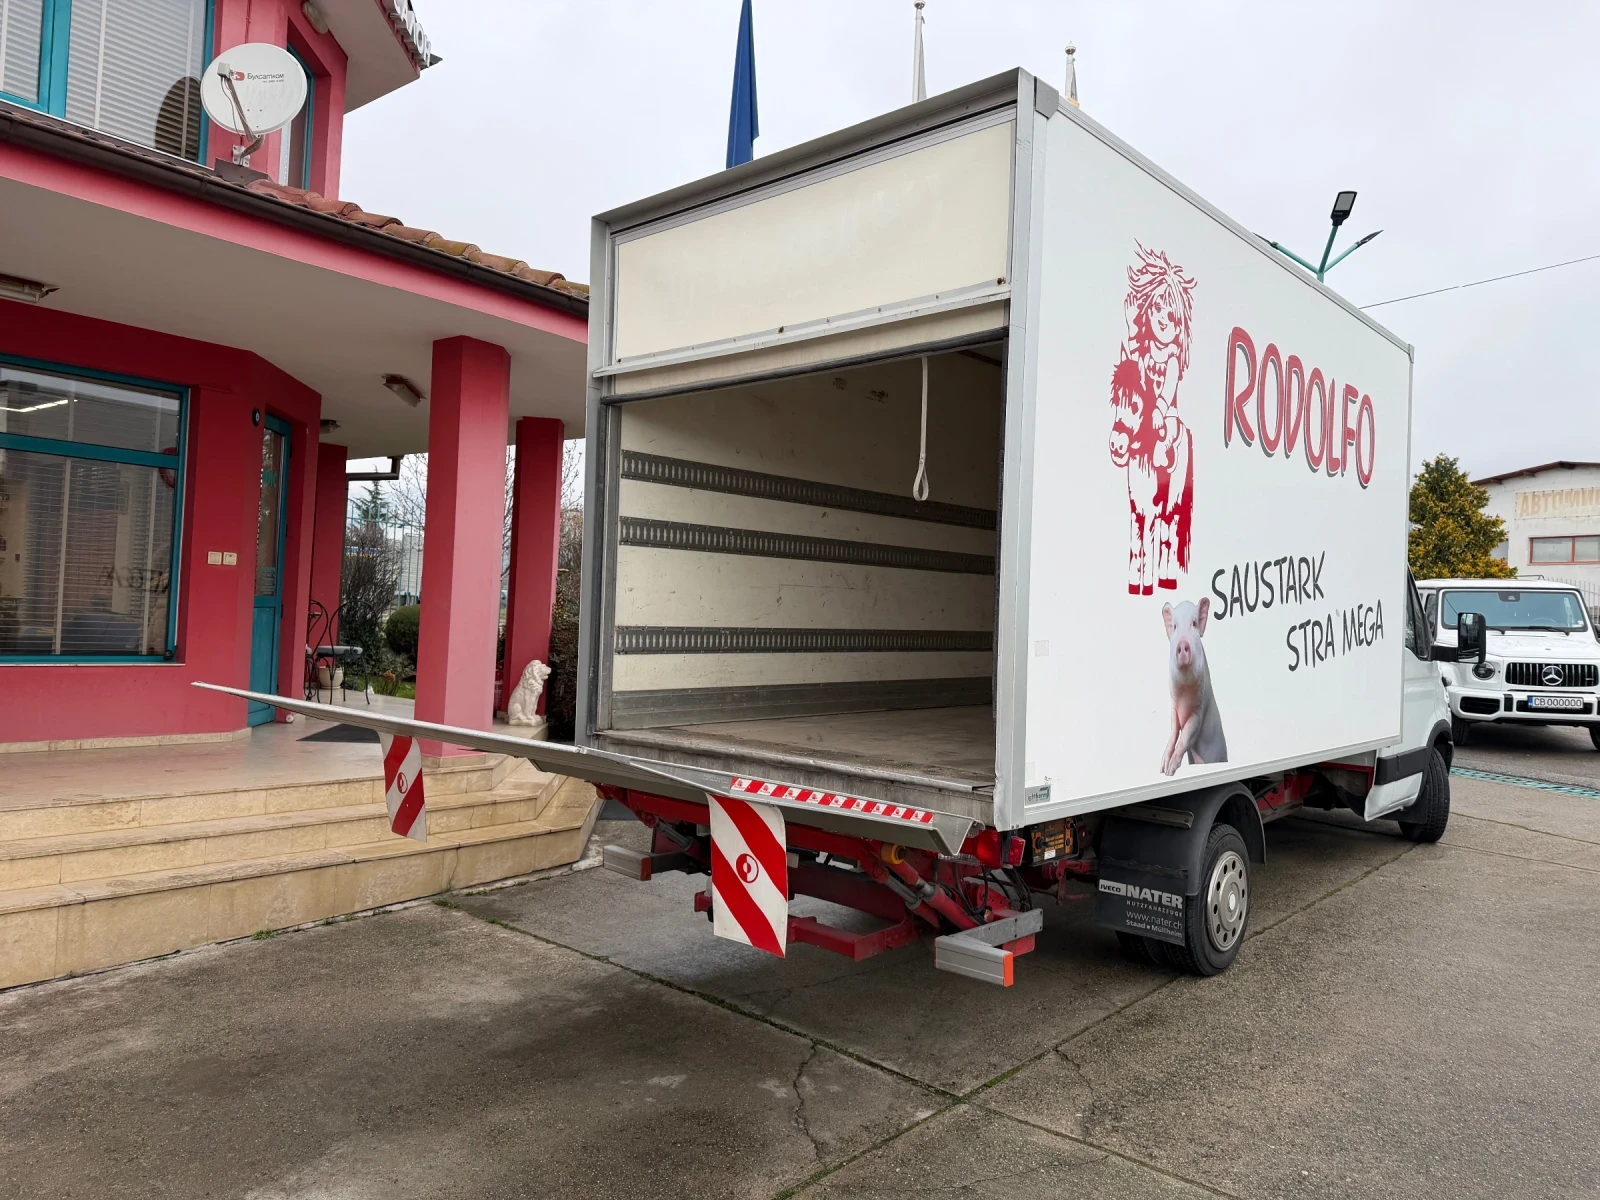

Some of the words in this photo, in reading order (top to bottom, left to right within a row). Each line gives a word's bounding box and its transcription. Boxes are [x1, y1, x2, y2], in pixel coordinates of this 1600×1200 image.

[1224, 327, 1375, 490] RODOLFO
[1211, 550, 1326, 620] SAUSTARK
[1286, 613, 1335, 672] STRA
[1342, 599, 1384, 656] MEGA
[1100, 883, 1121, 893] IVECO
[1126, 884, 1183, 909] NATER
[1126, 900, 1183, 917] NUTZFAHRZEUGE
[1126, 911, 1183, 930] www.nater.ch
[1126, 920, 1146, 929] Staad
[1151, 924, 1183, 938] Müllheim
